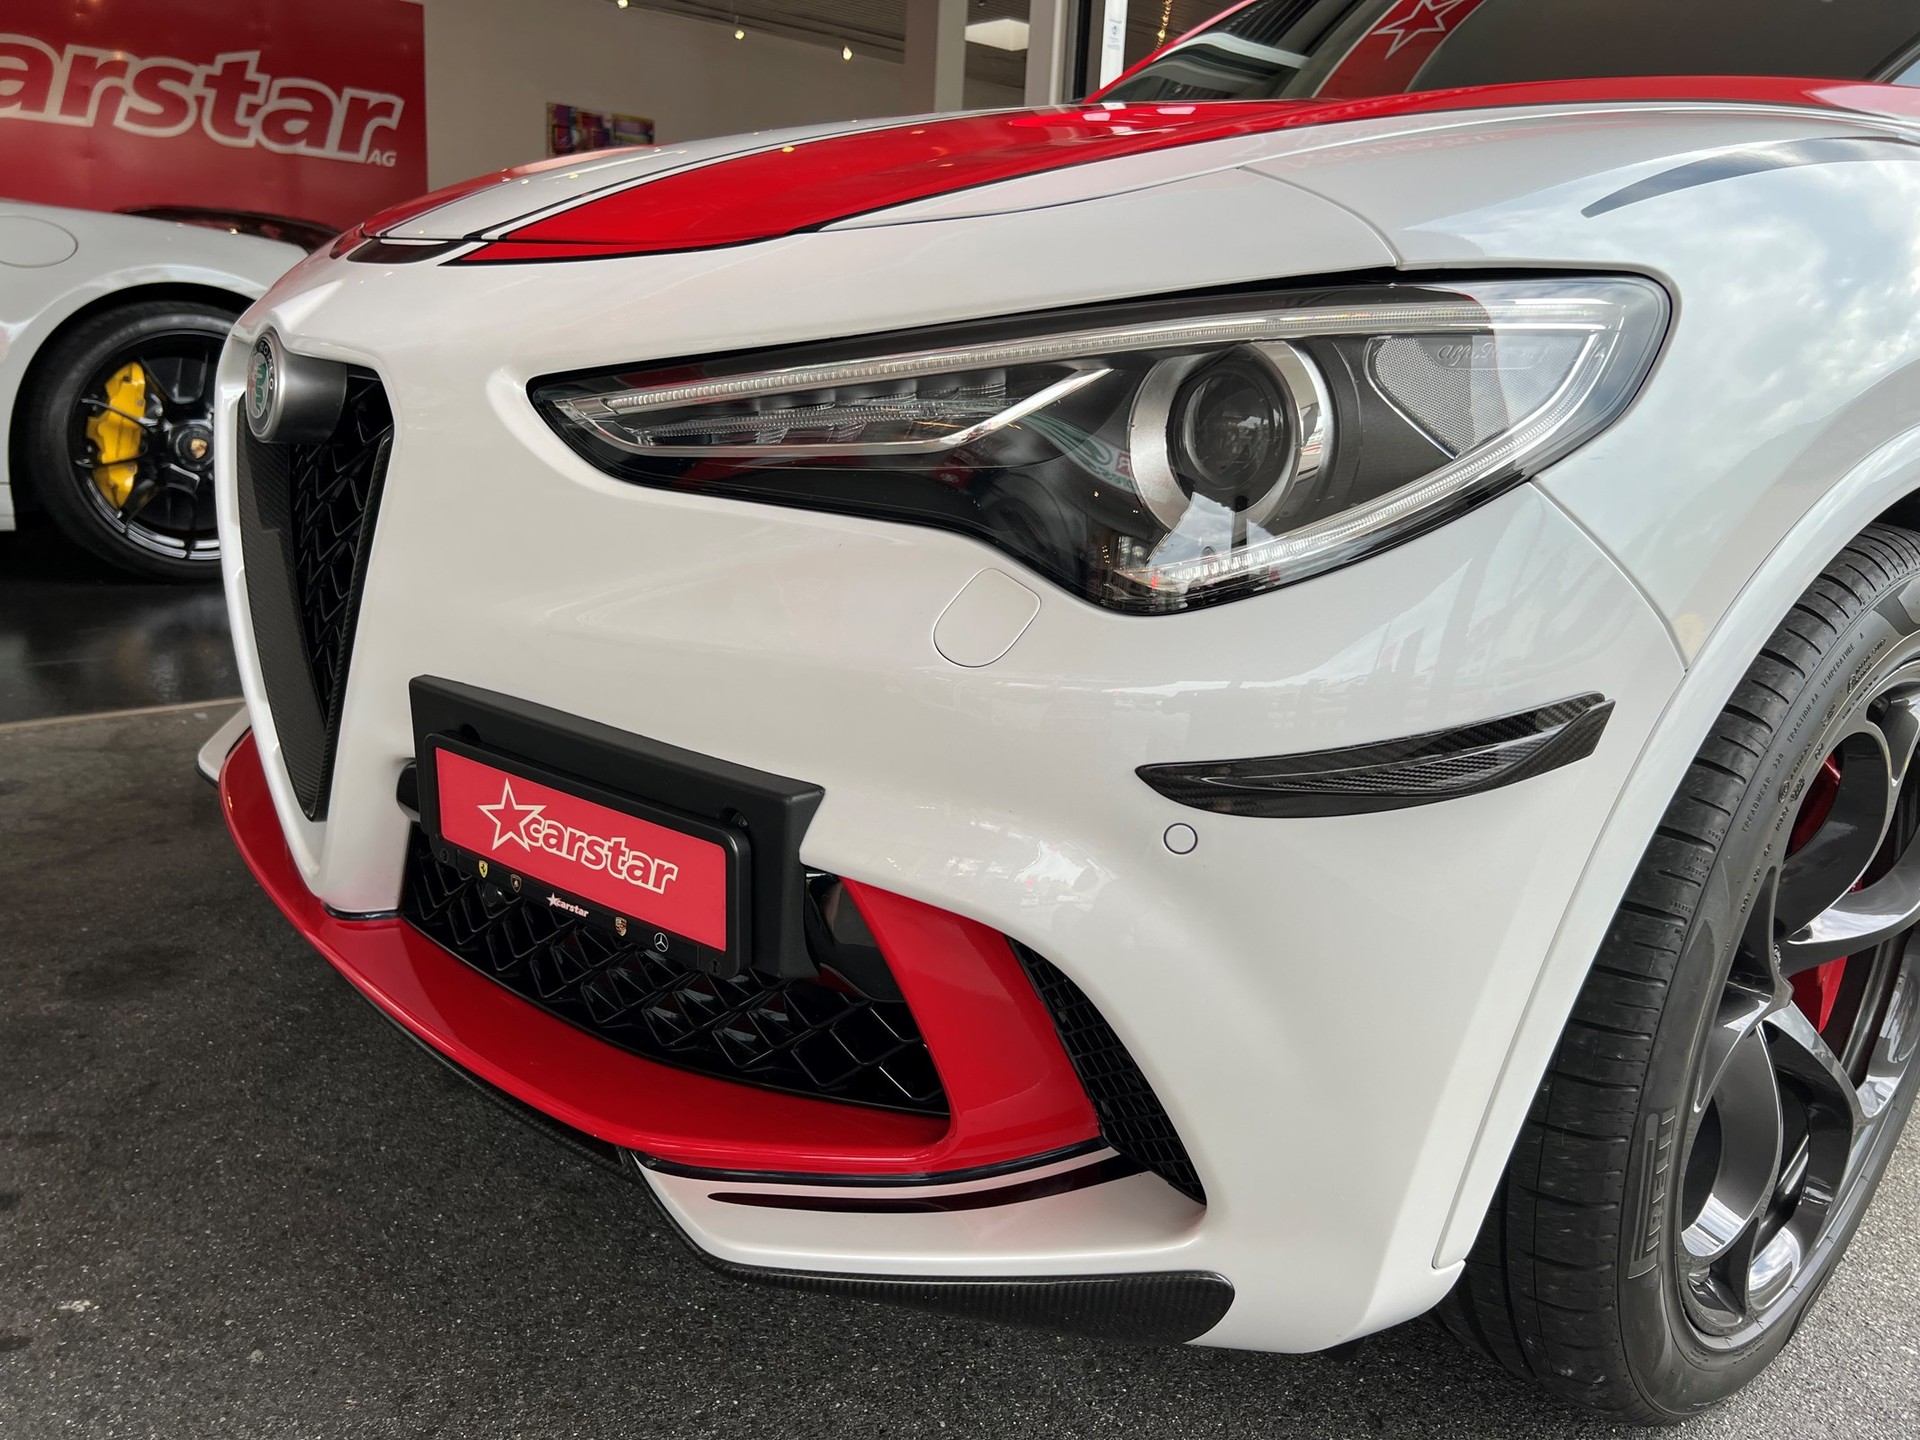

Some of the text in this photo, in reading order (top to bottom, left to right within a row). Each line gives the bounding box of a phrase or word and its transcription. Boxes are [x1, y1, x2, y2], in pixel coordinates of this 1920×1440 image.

[366, 150, 397, 168] AG
[1741, 776, 1771, 833] TREADWEAR
[1786, 704, 1812, 744] TRACTION
[1821, 643, 1855, 688] TEMPERATURE
[520, 815, 679, 894] carstar
[555, 900, 589, 918] carstar
[1627, 1103, 1677, 1281] PIRELLI
